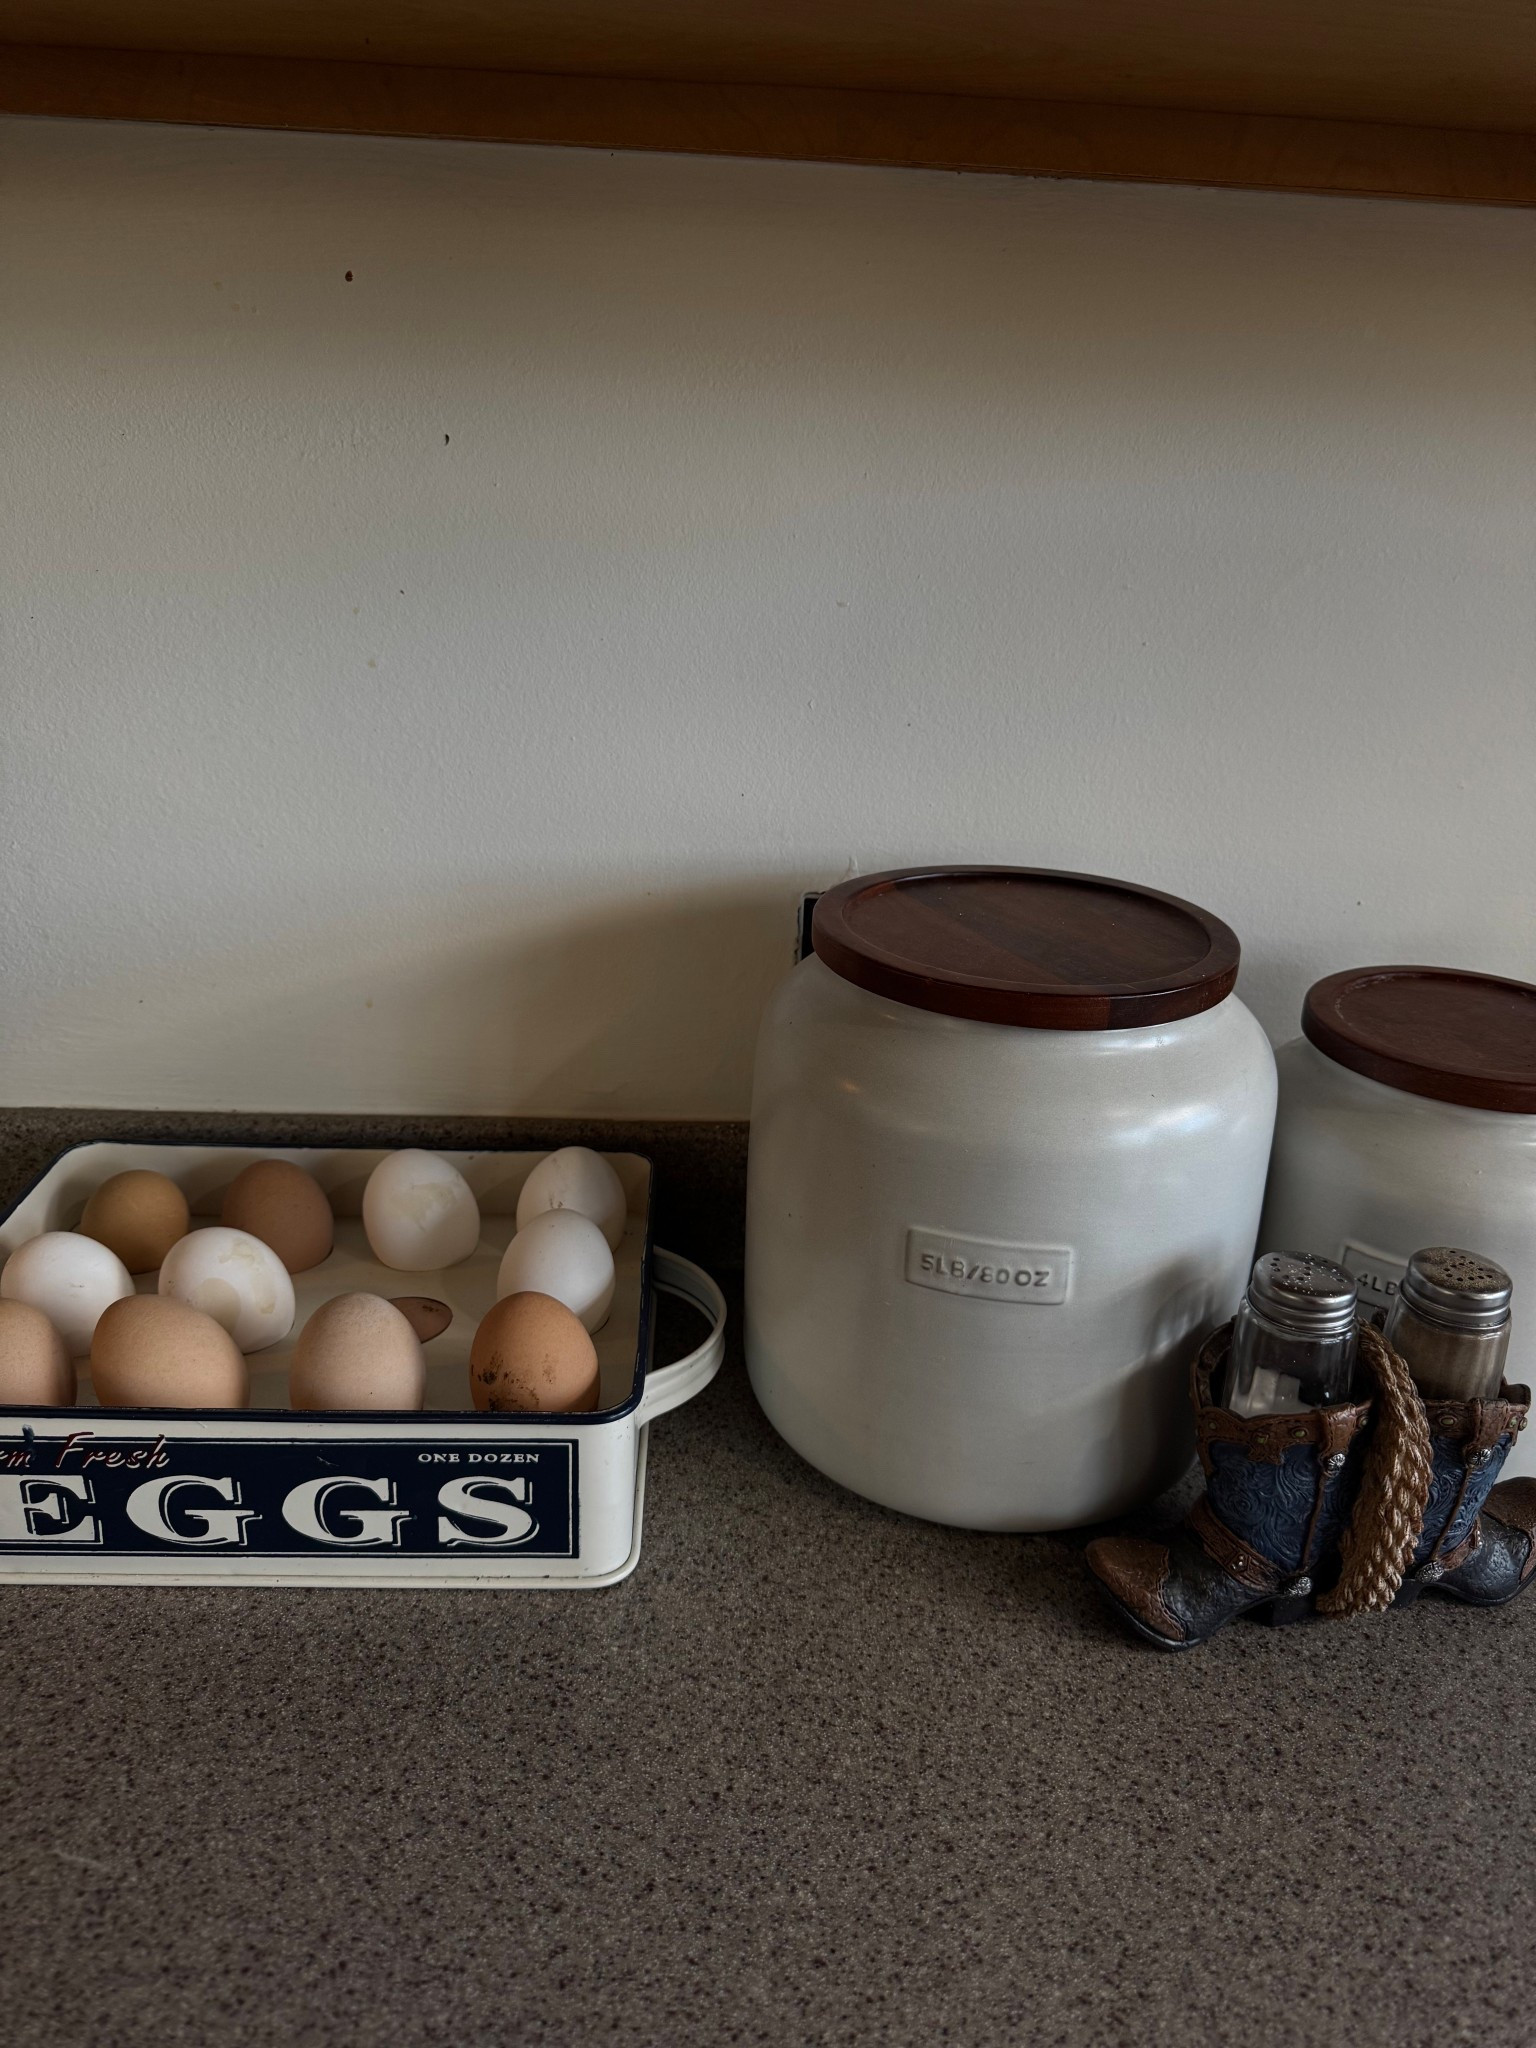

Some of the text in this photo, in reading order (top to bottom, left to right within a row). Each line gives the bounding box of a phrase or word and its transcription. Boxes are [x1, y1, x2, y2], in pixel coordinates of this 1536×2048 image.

[55, 1431, 170, 1469] Fresh
[418, 1452, 540, 1464] ONE DOZEN
[0, 1474, 540, 1548] EGGS
